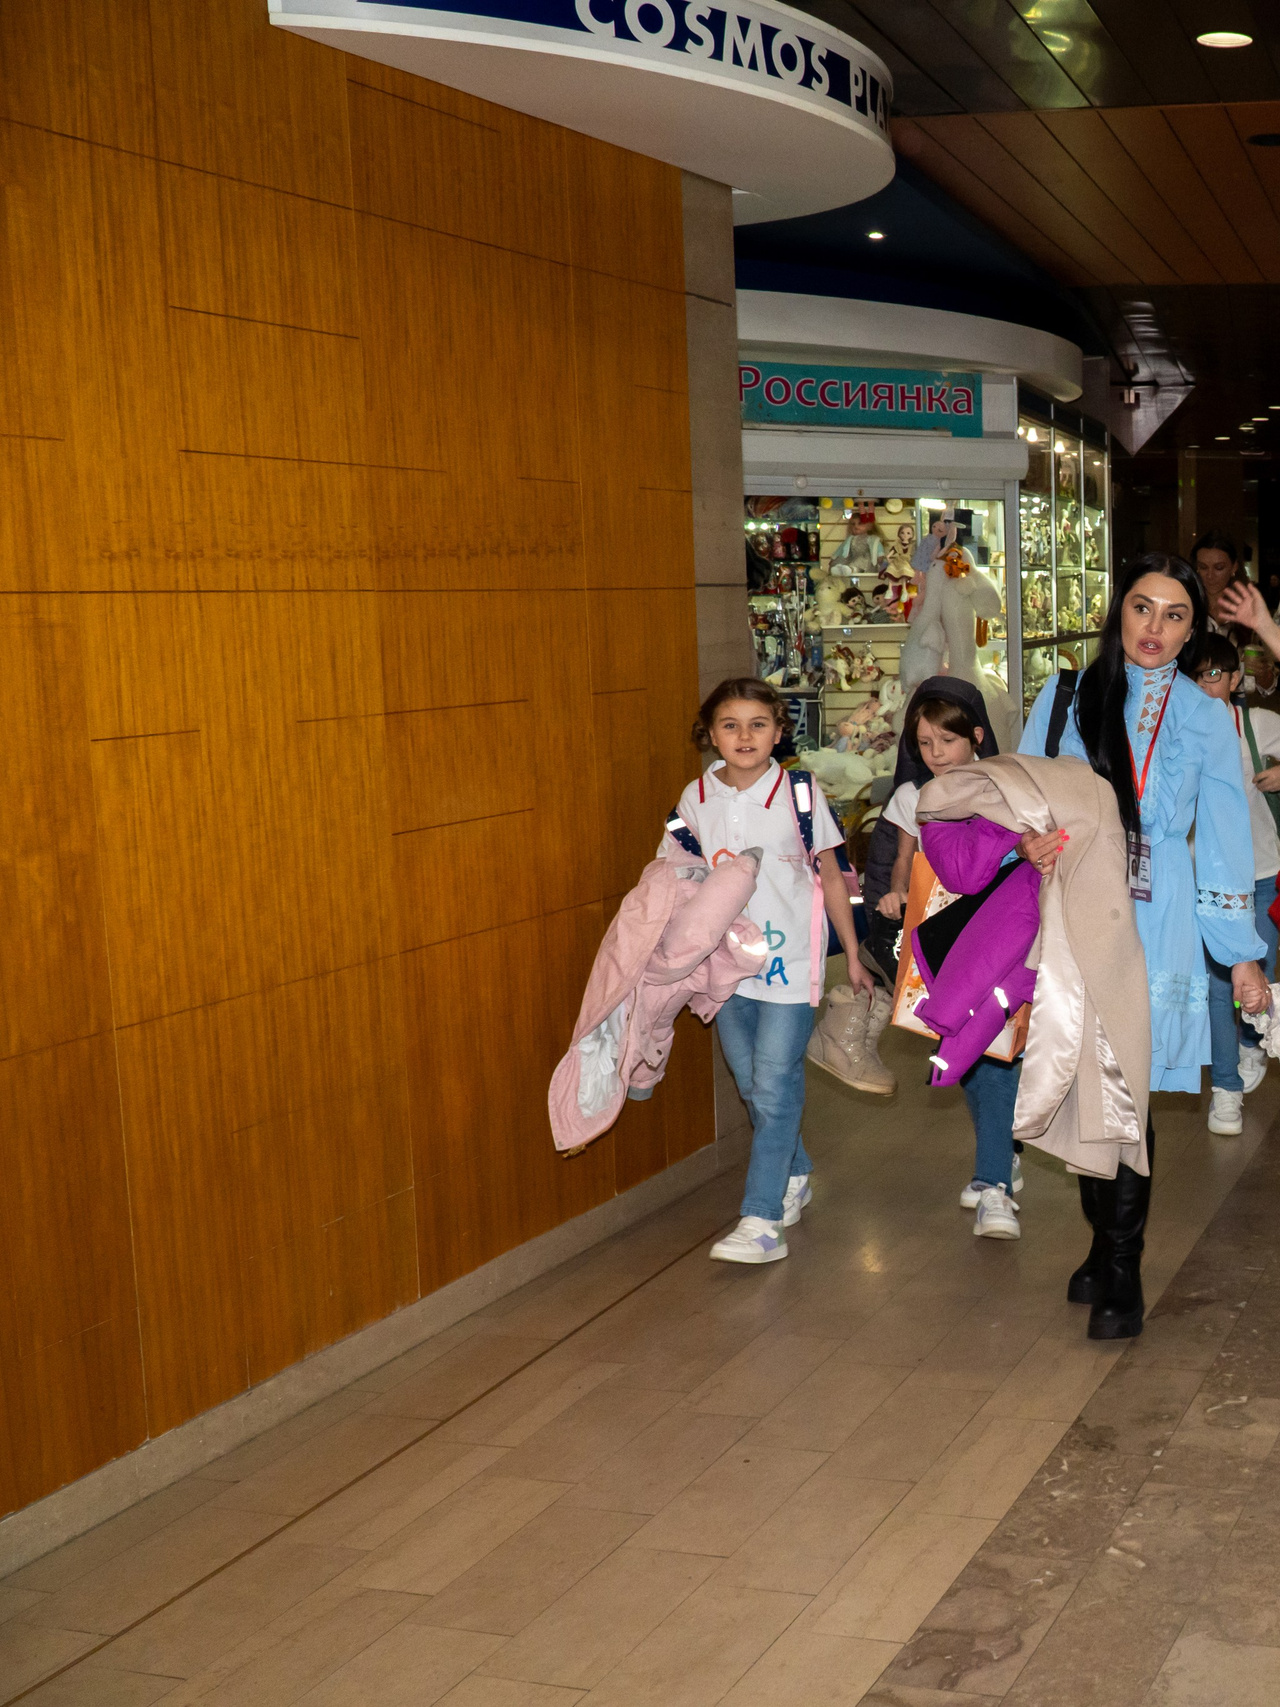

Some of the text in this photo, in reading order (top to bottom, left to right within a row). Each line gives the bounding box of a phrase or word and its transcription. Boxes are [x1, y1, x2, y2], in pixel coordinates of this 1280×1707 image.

[575, 0, 889, 134] COSMOS PLA
[738, 365, 975, 416] Россиянка
